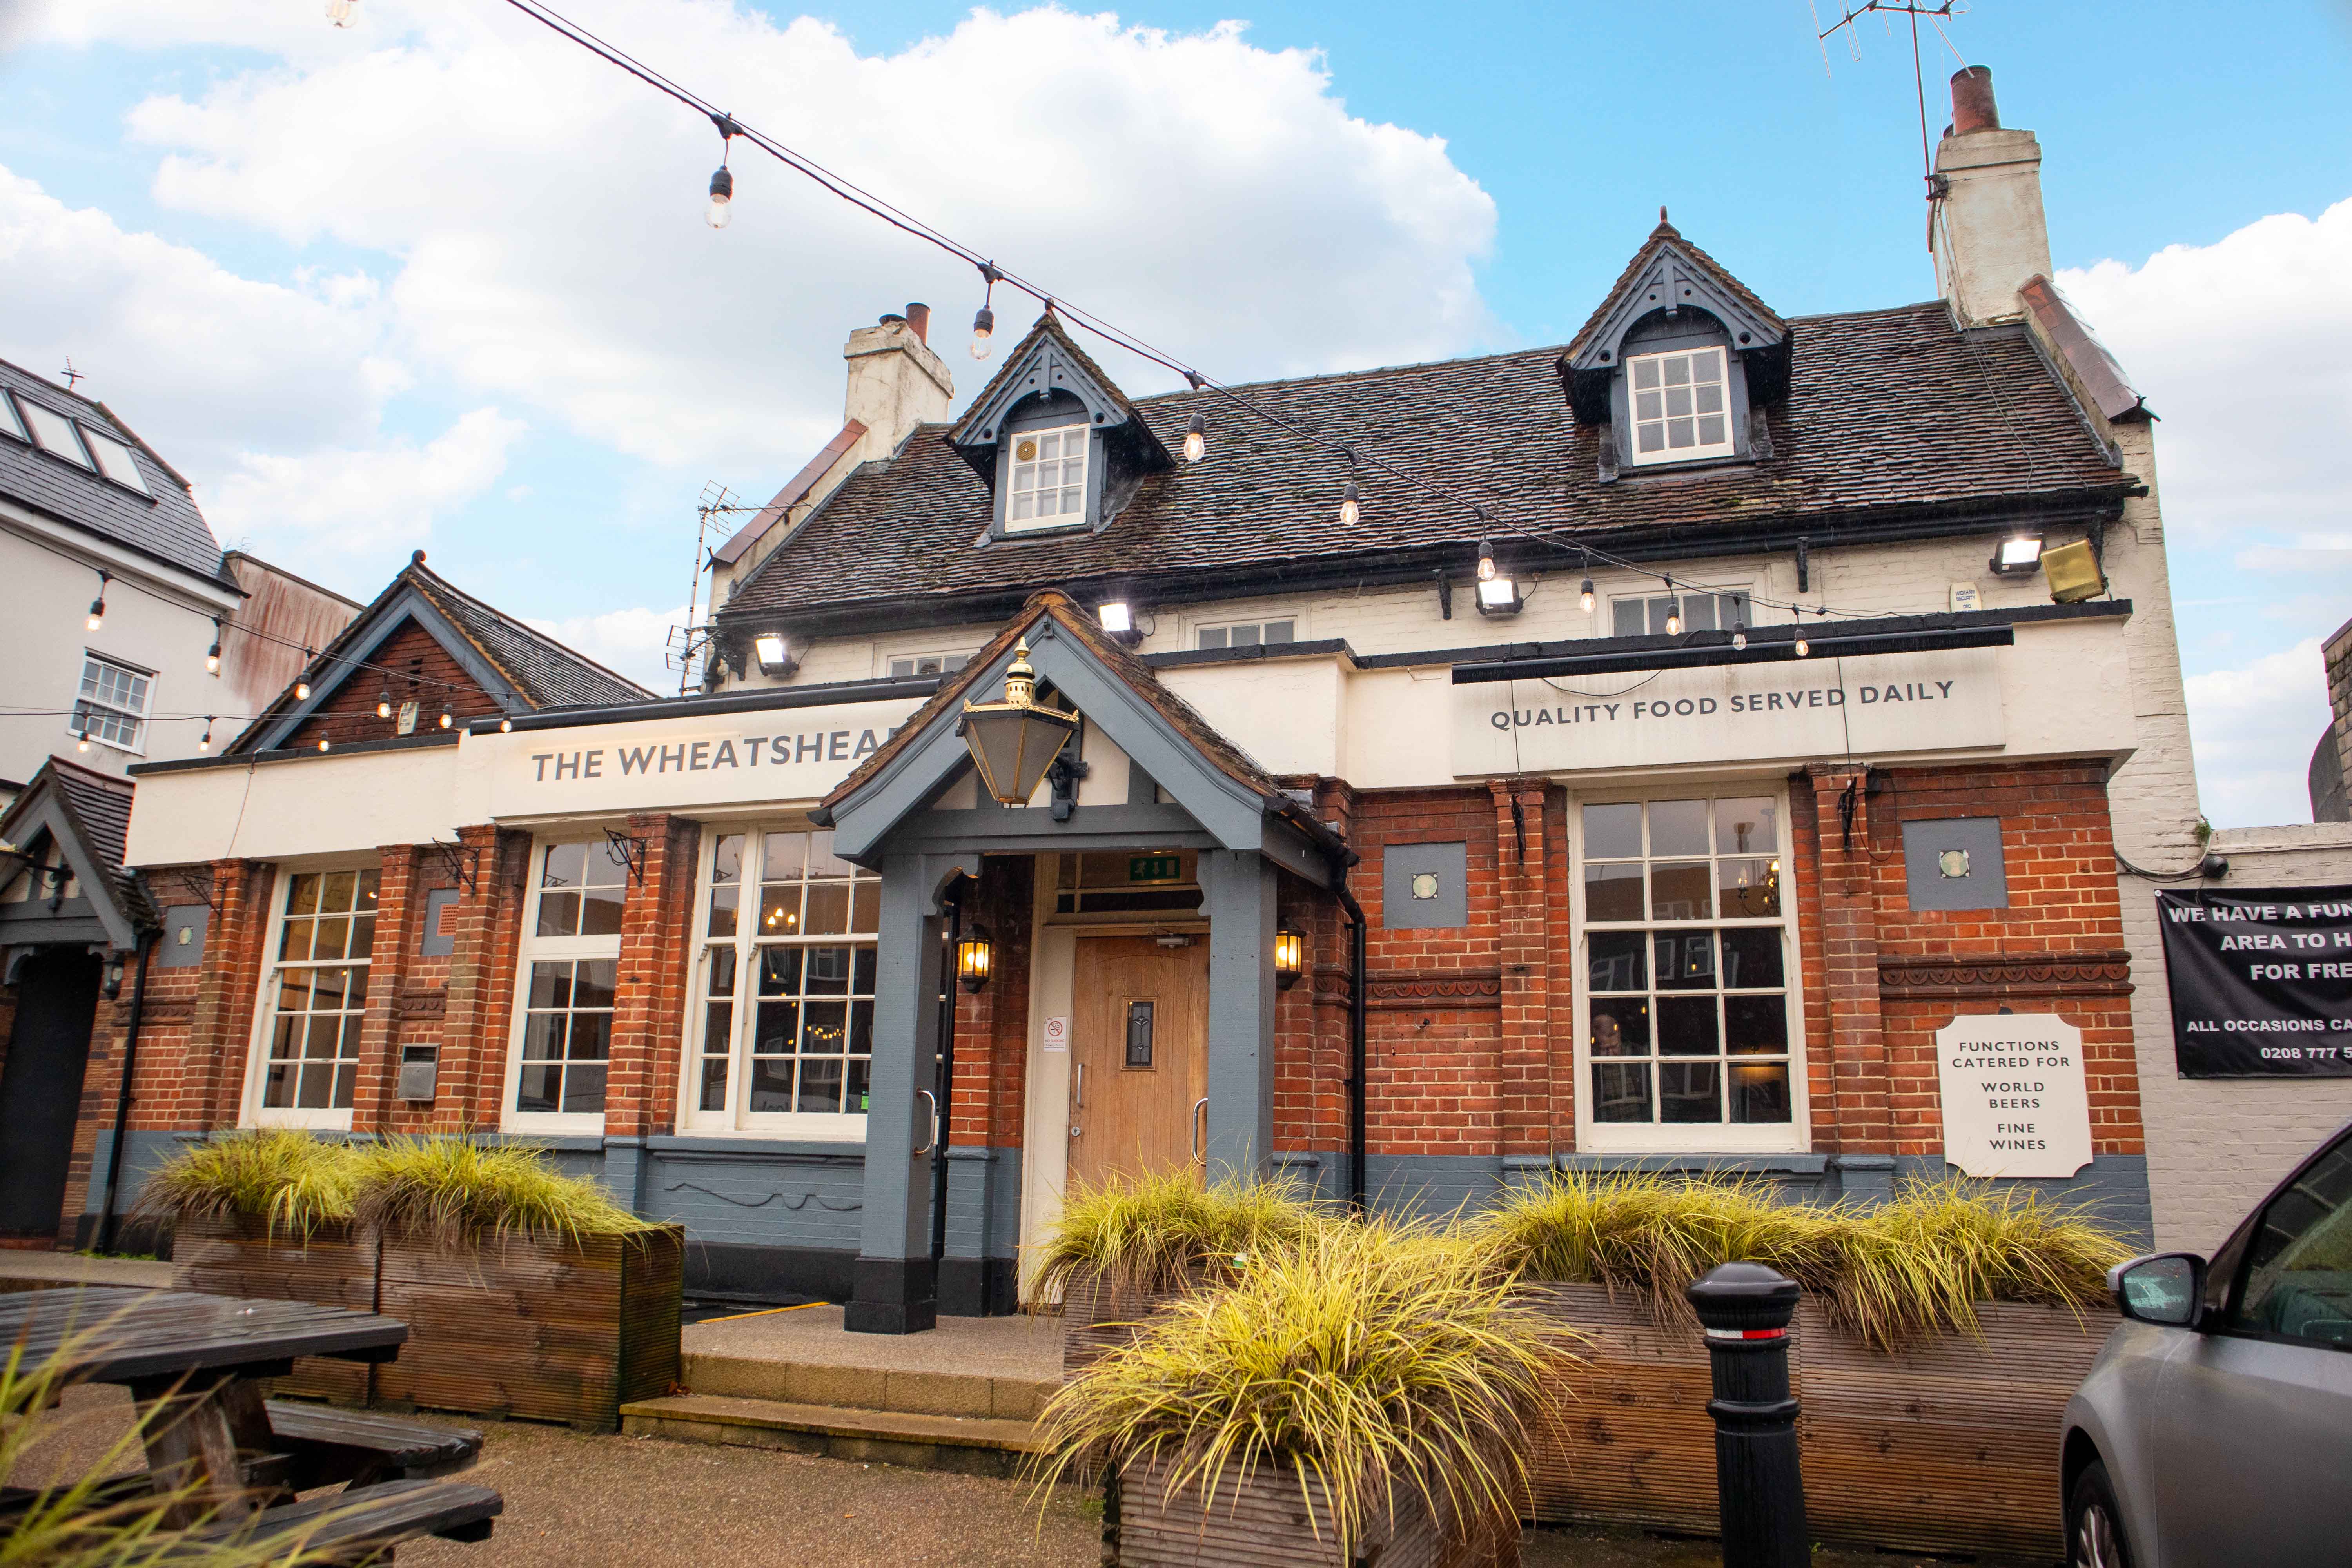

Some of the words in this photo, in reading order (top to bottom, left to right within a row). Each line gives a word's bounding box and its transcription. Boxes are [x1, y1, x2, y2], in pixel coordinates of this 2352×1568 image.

[1490, 703, 1622, 731] QUALITY
[1633, 698, 1717, 719] FOOD
[1731, 688, 1846, 713] SERVED
[1860, 680, 1955, 704] DAILY
[532, 750, 604, 781] THE
[618, 727, 901, 776] WHEATSHEA
[2168, 907, 2205, 922] WE
[2212, 906, 2278, 922] HAVE
[2285, 906, 2303, 919] A
[2220, 935, 2287, 951] AREA
[2291, 933, 2326, 948] TO
[2250, 964, 2301, 980] FOR
[2187, 1021, 2220, 1032] ALL
[2224, 1019, 2325, 1031] OCCASIONS
[1959, 1041, 2060, 1051] FUNCTIONS
[2261, 1048, 2301, 1059] 0208
[2306, 1047, 2337, 1059] 777
[1952, 1058, 2029, 1068] CATERED
[2036, 1057, 2070, 1067] FOR
[1982, 1082, 2044, 1092] WORLD
[1989, 1099, 2040, 1108] BEERS
[1998, 1123, 2035, 1133] FINE
[1990, 1140, 2046, 1150] WINES
